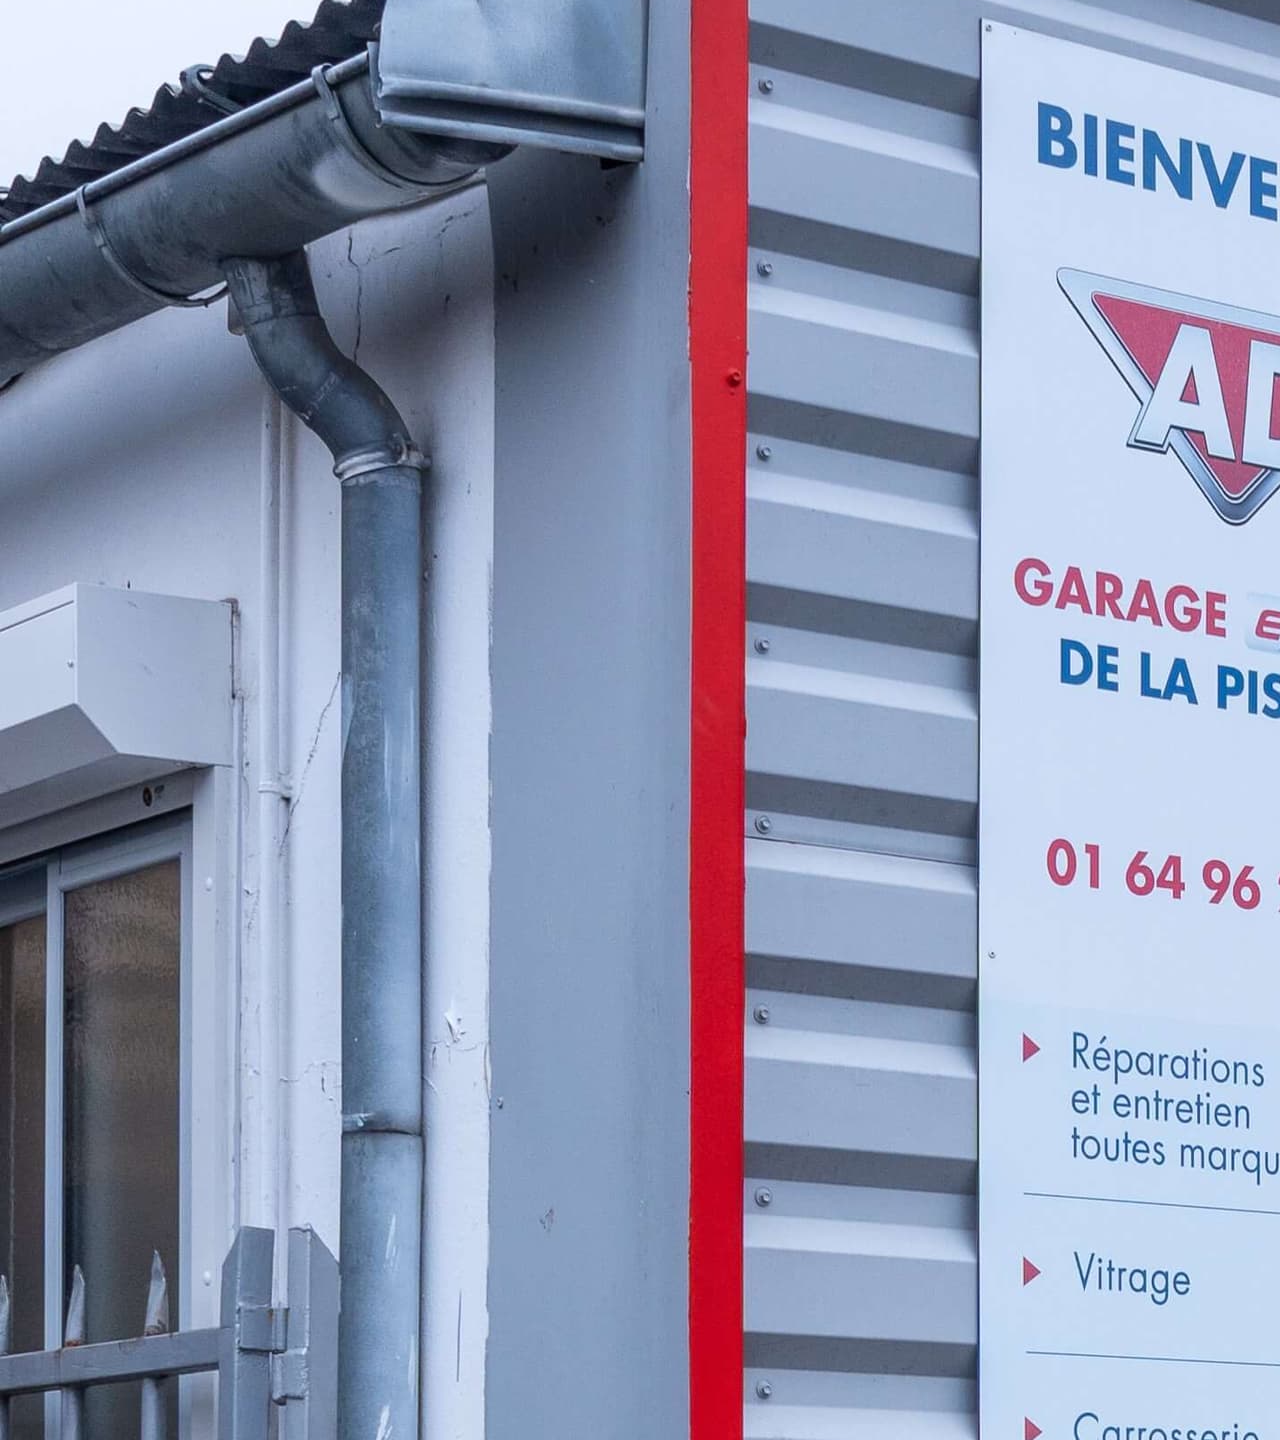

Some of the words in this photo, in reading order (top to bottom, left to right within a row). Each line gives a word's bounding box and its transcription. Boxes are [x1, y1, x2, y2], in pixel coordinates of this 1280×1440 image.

[1015, 558, 1226, 638] GARAGE
[1061, 638, 1118, 692] DE
[1141, 652, 1198, 705] LA
[1047, 839, 1099, 888] 01
[1126, 851, 1185, 899] 64
[1203, 860, 1260, 909] 96
[1073, 1032, 1264, 1087] Réparations
[1072, 1084, 1100, 1114] et
[1113, 1090, 1249, 1129] entretien
[1072, 1127, 1165, 1165] toutes
[1074, 1252, 1190, 1305] Vitrage
